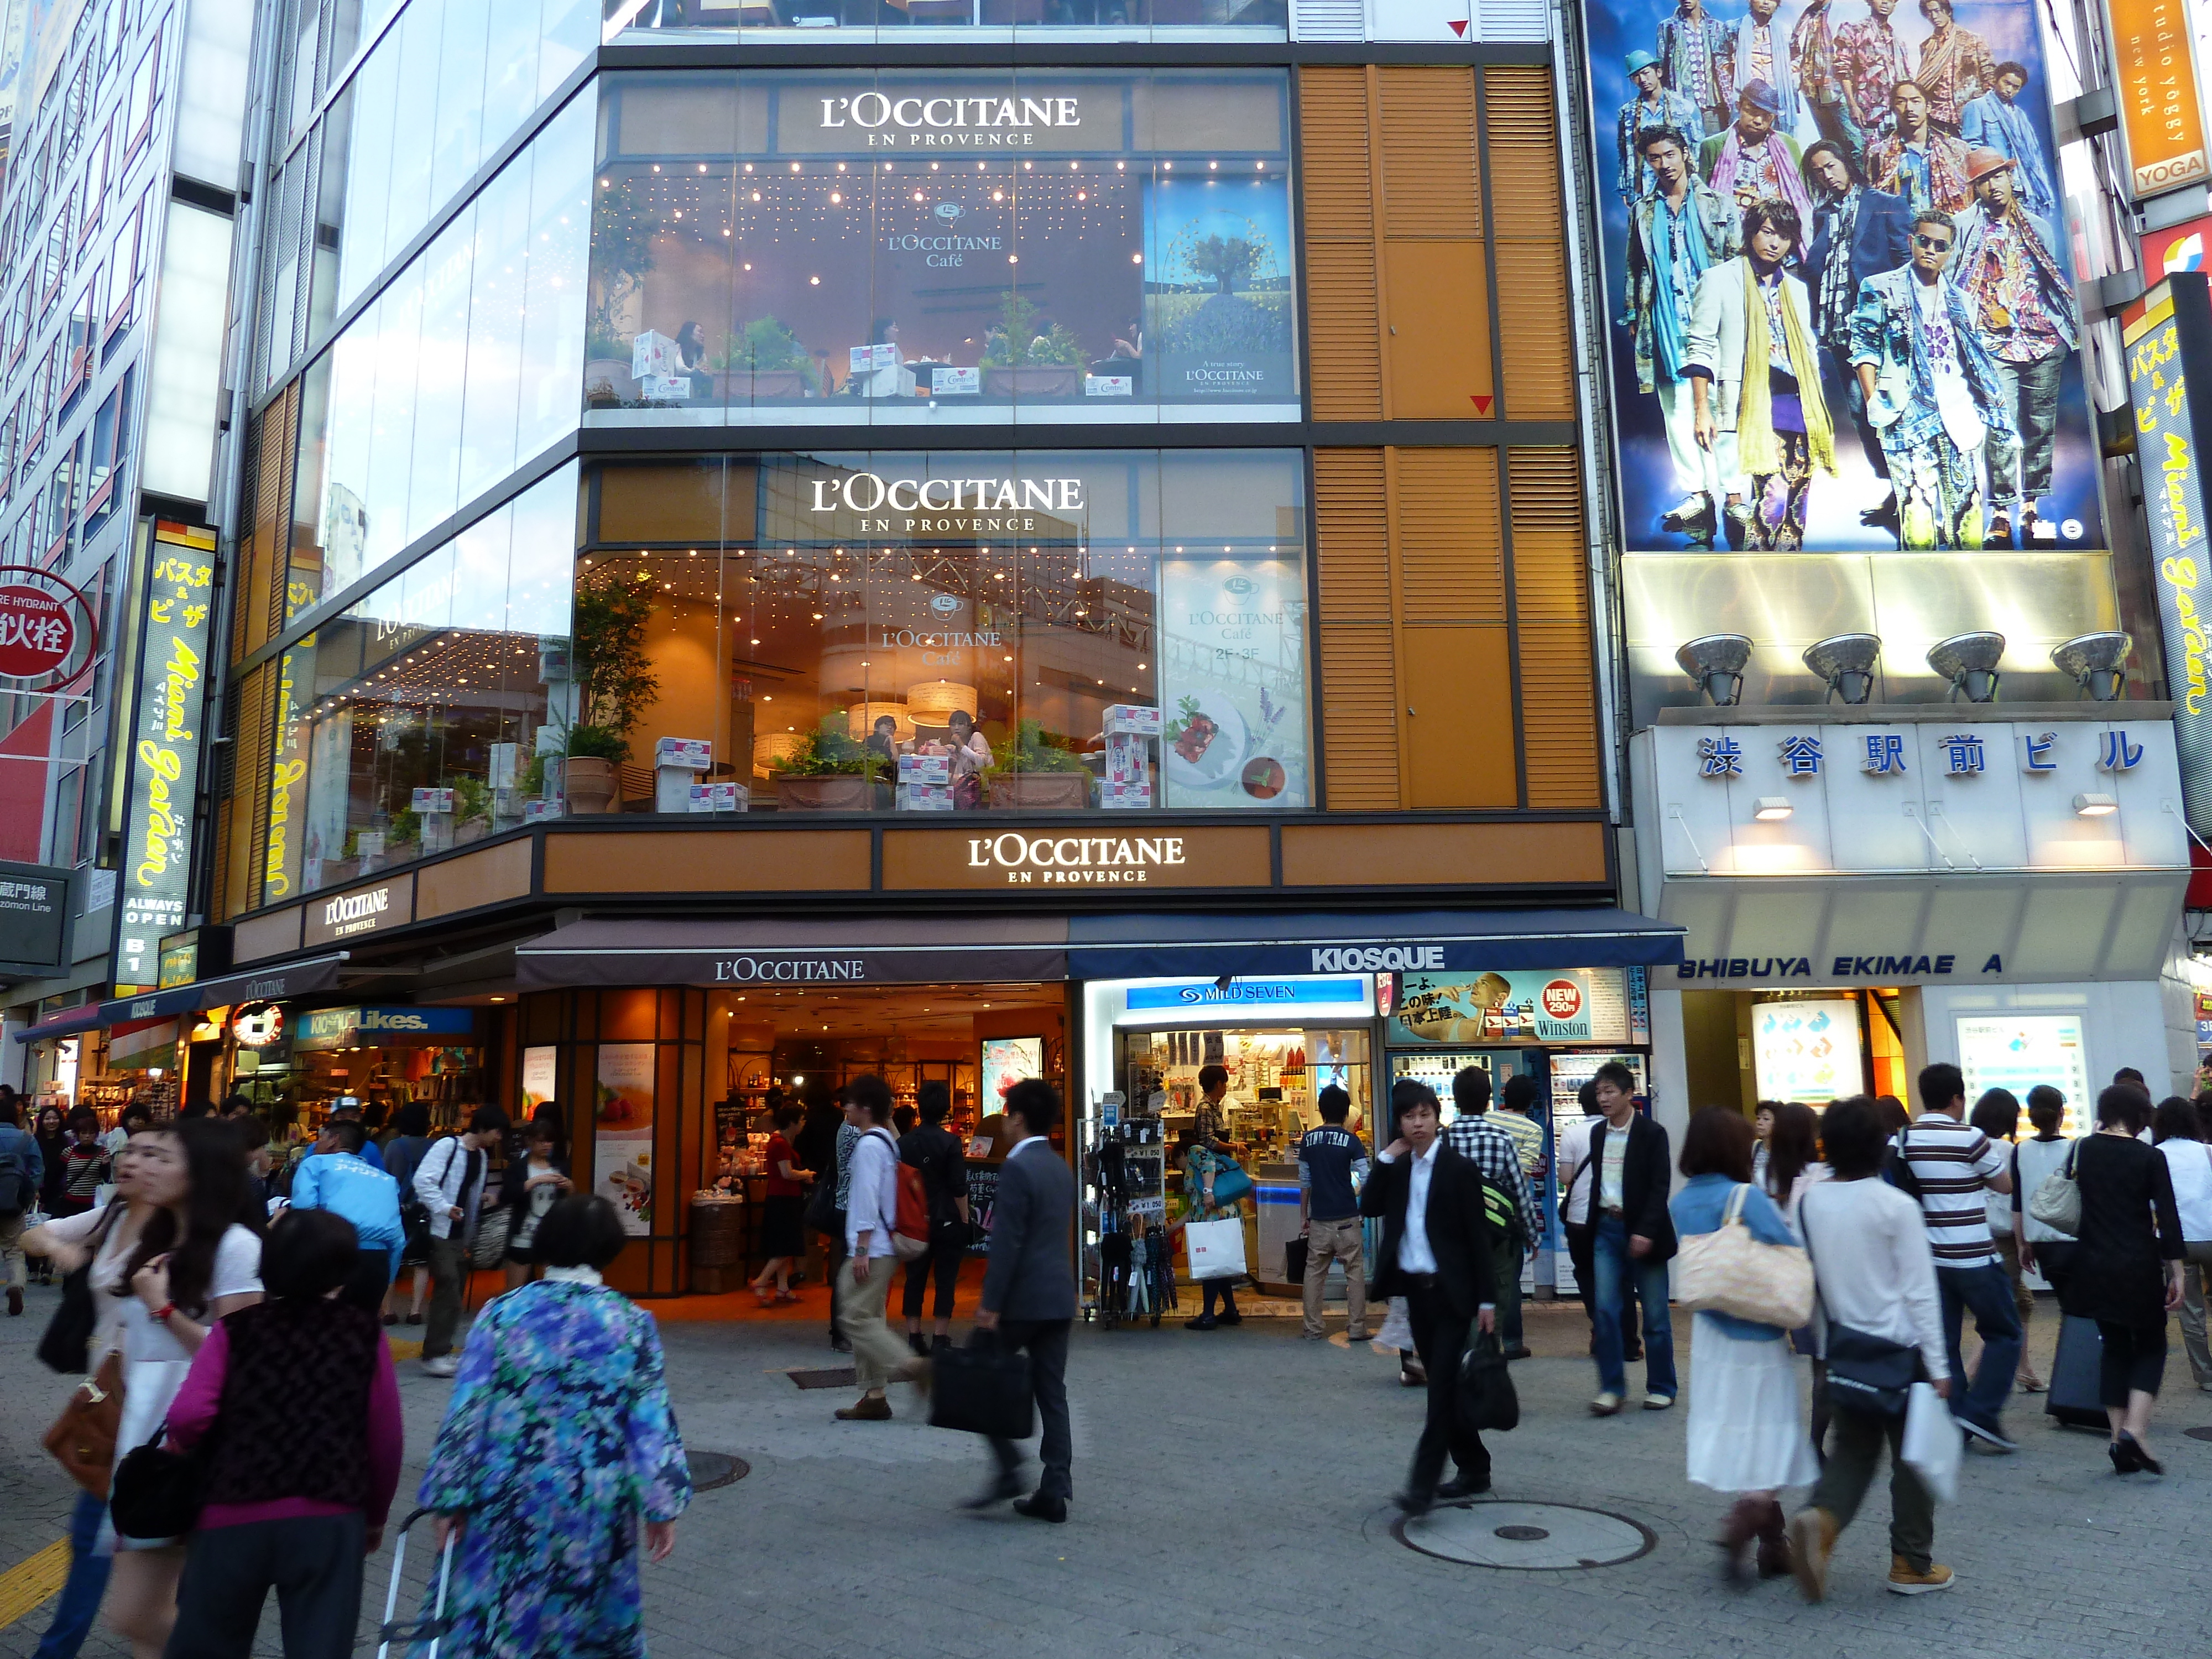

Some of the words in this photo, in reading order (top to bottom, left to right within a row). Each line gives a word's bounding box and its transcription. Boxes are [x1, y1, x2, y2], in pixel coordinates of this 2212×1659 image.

[2153, 0, 2174, 66] tudio
[2131, 36, 2143, 67] new
[2133, 76, 2154, 116] york
[820, 92, 1081, 128] L'OCCITANE
[868, 134, 895, 145] EN
[911, 133, 1034, 145] PROVENCE
[2138, 155, 2203, 186] YOGA
[888, 235, 1001, 251] L'OCCITANE
[926, 254, 963, 268] Café
[2130, 327, 2179, 382] パスタ
[1186, 369, 1264, 380] L'OCCITANE
[2151, 371, 2165, 390] &
[2137, 375, 2185, 433] ピザ
[810, 473, 1084, 512] L'OCCITANE
[860, 519, 890, 531] EN
[905, 518, 1034, 531] PROVENCE
[154, 557, 212, 587] パスタ
[176, 586, 189, 599] &
[13, 596, 60, 612] HYDRANT
[151, 598, 208, 628] ピザ
[1189, 611, 1284, 625] L'OCCITANE
[882, 630, 1001, 648] L'OCCITANE
[1222, 628, 1251, 640] Café
[922, 651, 961, 665] Café
[1701, 730, 2143, 777] 渋谷駅前ビル
[968, 833, 1186, 867] L'OCCITANE
[1008, 871, 1032, 883] EN
[1044, 870, 1147, 883] PROVENCE
[33, 902, 51, 912] Line
[127, 897, 183, 912] ALWAYS
[325, 888, 388, 925] L'OCCITANE
[126, 912, 182, 926] OPEN
[346, 918, 376, 935] PROVENCE
[1312, 946, 1445, 972] KIOSQUE
[1677, 957, 1812, 979] SHIBUYA
[1832, 954, 1955, 976] EKIMAE
[1983, 954, 2002, 973] A
[714, 957, 864, 981] L'OCCITANE
[1206, 987, 1242, 1000] MILD
[1245, 985, 1295, 999] SEVEN
[1546, 989, 1576, 1001] NEW
[1549, 1002, 1575, 1012] 290円
[1400, 1006, 1458, 1026] 日本上陸。
[1537, 1020, 1588, 1036] Winston
